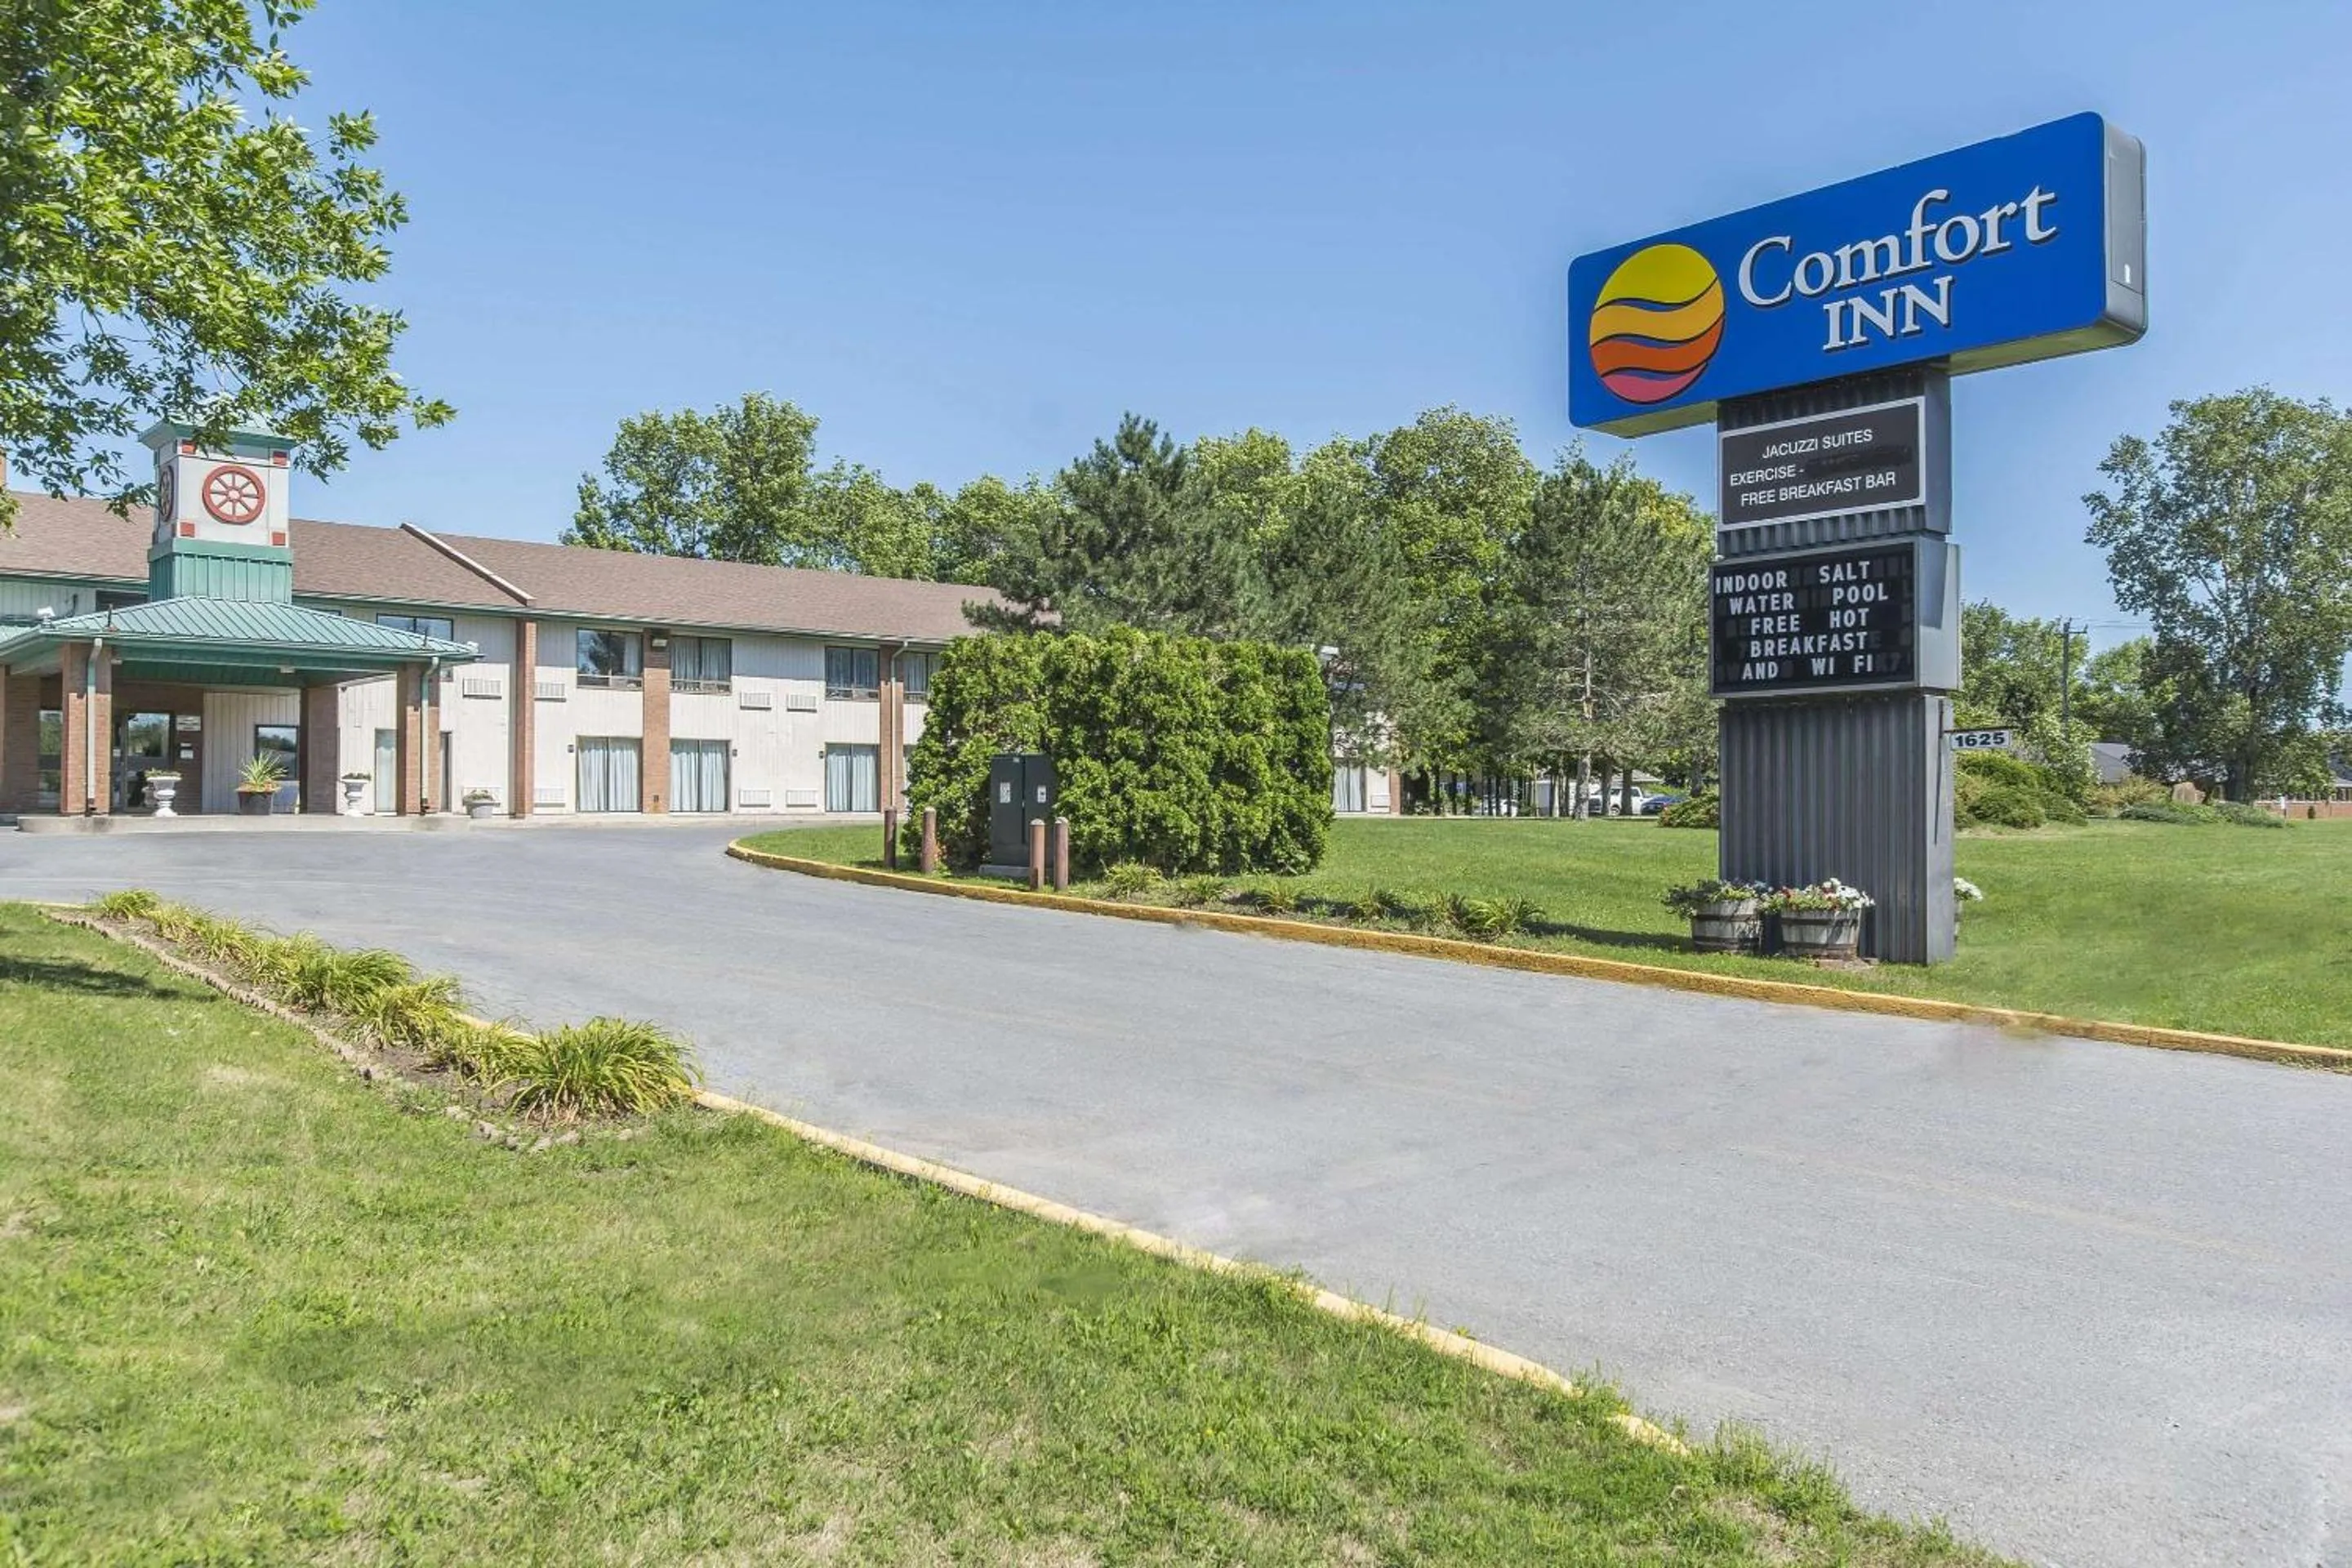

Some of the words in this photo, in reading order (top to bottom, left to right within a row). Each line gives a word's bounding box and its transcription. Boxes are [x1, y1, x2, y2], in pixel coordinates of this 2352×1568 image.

[1737, 185, 2058, 307] Comfort
[1821, 275, 1954, 351] INN
[1762, 438, 1818, 459] JACUZZI
[1823, 429, 1873, 449] SUITES
[1730, 464, 1796, 486] EXERCISE
[1740, 489, 1775, 507] FREE
[1779, 477, 1862, 501] BREAKFAST
[1865, 471, 1895, 489] BAR
[1716, 571, 1788, 595] INDOOR
[1819, 560, 1870, 585] SALT
[1729, 594, 1794, 616] WATER
[1832, 582, 1888, 606] POOL
[1750, 613, 1801, 636] FREE
[1829, 608, 1870, 630] HOT
[1750, 631, 1869, 658] BREAKFAST
[1742, 661, 1779, 680] AND
[1811, 657, 1835, 677] WI
[1854, 654, 1874, 674] FI
[1954, 732, 2006, 748] 1625
